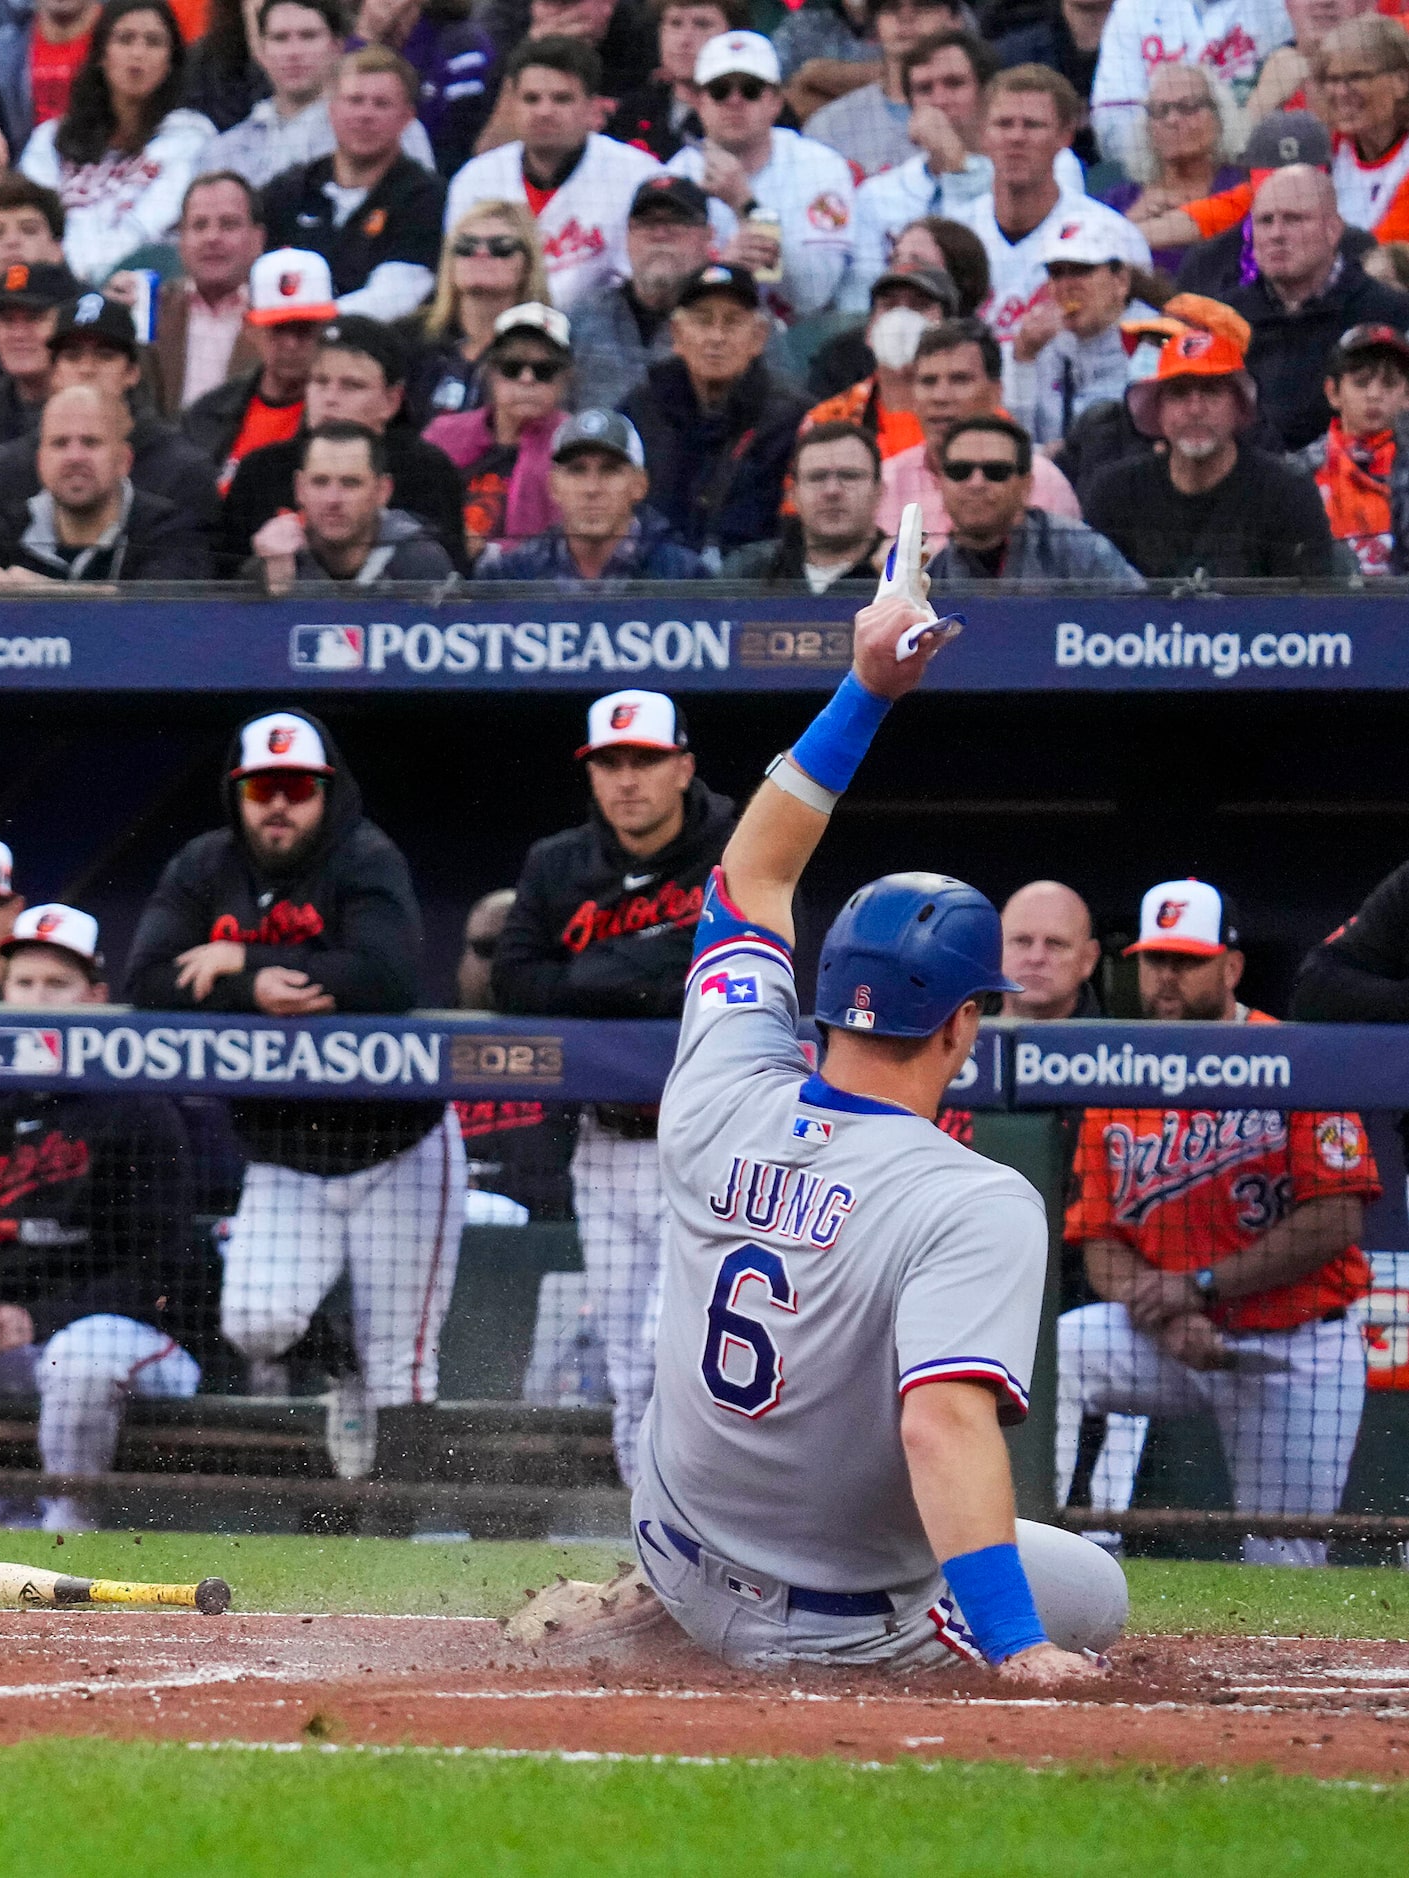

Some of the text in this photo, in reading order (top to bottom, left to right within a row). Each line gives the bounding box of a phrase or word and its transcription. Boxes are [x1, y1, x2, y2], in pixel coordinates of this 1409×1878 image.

[368, 621, 852, 671] POSTSEASON 2023
[1055, 622, 1352, 677] Booking.com
[855, 984, 872, 1009] 6
[65, 1027, 563, 1085] POSTSEASON 2023
[1014, 1042, 1291, 1095] Booking.com
[709, 1156, 857, 1251] JUNG
[699, 1242, 799, 1420] 6
